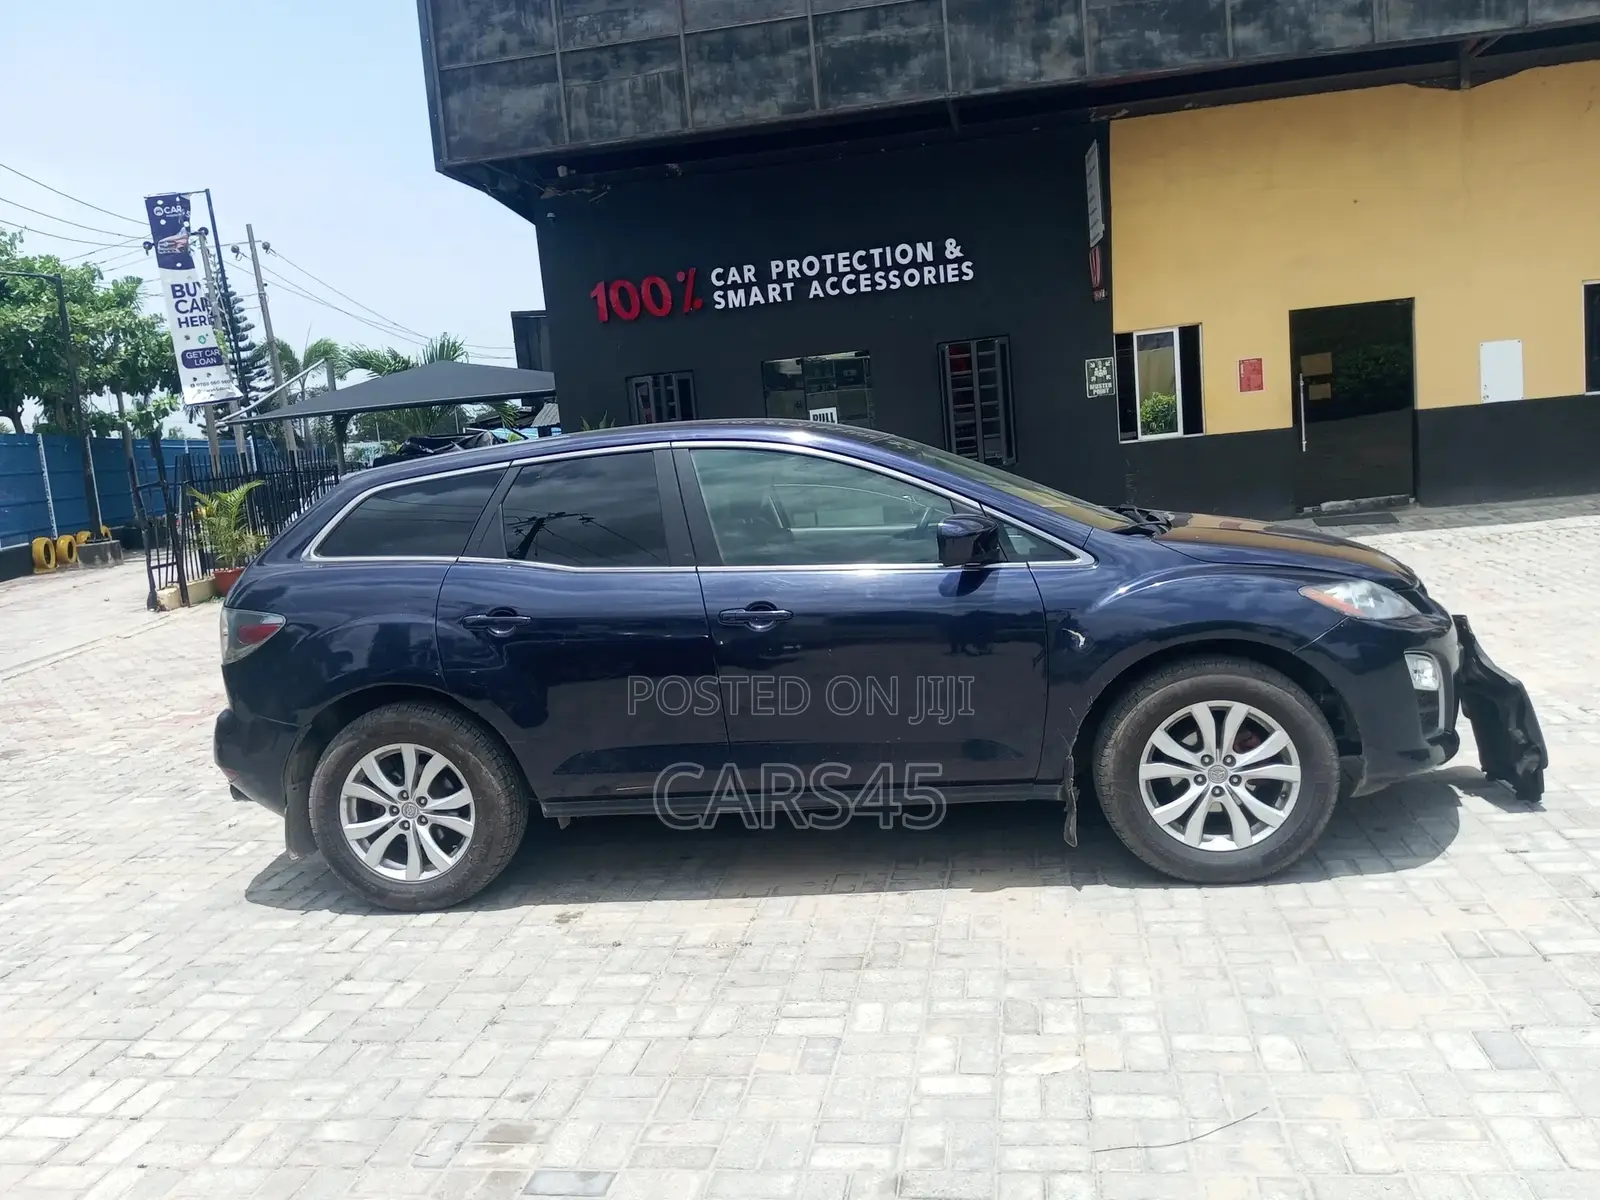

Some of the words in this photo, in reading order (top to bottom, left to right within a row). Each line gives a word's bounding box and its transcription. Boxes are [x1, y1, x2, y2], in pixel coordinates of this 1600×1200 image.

[711, 264, 757, 287] CAR
[770, 241, 934, 280] PROTECTION
[944, 238, 964, 260] &
[590, 267, 703, 323] 100%
[713, 282, 795, 310] SMART
[808, 261, 974, 299] ACCESSORIES
[185, 351, 203, 359] GET
[204, 348, 220, 357] CAR
[194, 357, 217, 366] LOAN
[812, 411, 836, 424] PULL
